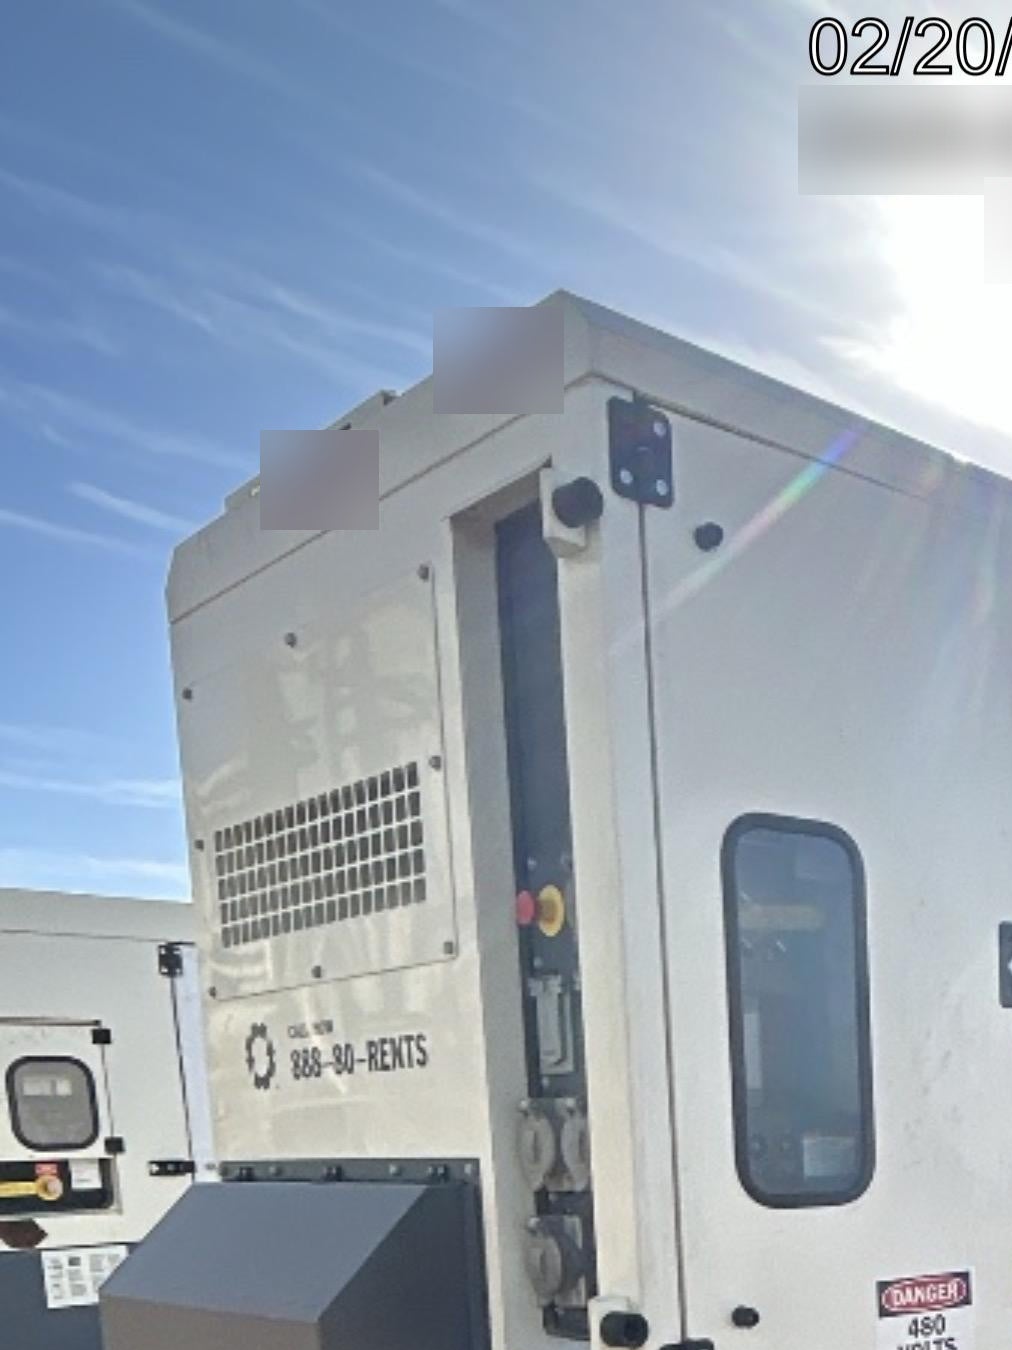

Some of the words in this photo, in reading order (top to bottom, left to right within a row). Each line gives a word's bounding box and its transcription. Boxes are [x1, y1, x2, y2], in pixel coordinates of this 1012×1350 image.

[290, 1033, 428, 1080] 888-80-RENTS
[891, 1276, 959, 1307] DANGER
[908, 1312, 946, 1339] 480
